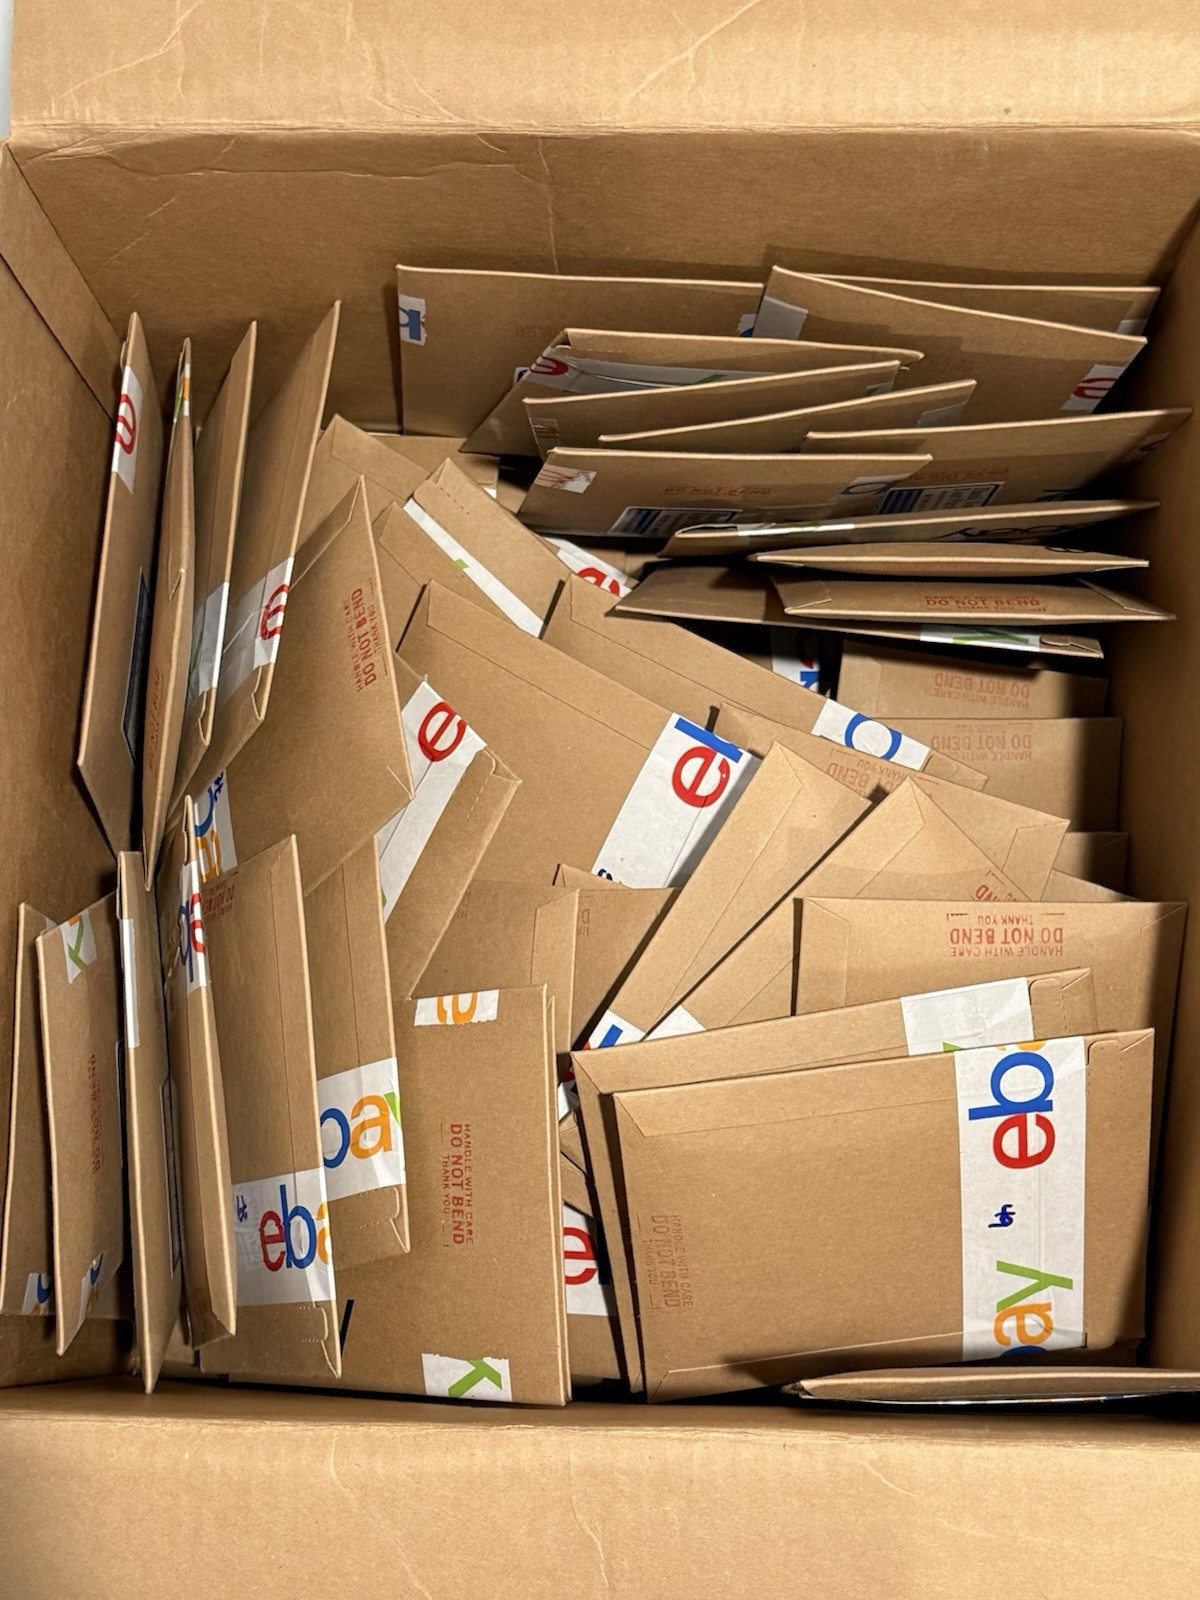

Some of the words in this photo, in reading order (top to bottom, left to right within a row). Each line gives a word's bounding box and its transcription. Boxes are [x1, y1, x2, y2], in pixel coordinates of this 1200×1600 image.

[351, 588, 367, 629] BEND
[926, 598, 949, 606] DO
[955, 598, 988, 606] NOT
[357, 631, 372, 661] NOT
[363, 662, 377, 686] DO
[934, 672, 973, 691] BEND
[976, 679, 1006, 696] NOT
[1010, 682, 1031, 699] DO
[931, 735, 972, 751] BEND
[976, 734, 1006, 751] NOT
[1011, 733, 1032, 750] DO
[977, 915, 998, 926] YOU
[1001, 914, 1034, 926] THANK
[950, 928, 995, 945] BEND
[1001, 927, 1034, 945] NOT
[1041, 927, 1064, 944] DO
[950, 946, 980, 957] CARE
[985, 946, 1014, 957] WITH
[1017, 946, 1063, 957] HANDLE
[968, 1041, 1056, 1169] eb
[450, 1123, 463, 1148] DO
[464, 1124, 472, 1172] HANDLE
[442, 1154, 450, 1189] THANK
[451, 1154, 464, 1190] NOT
[464, 1177, 473, 1207] WITH
[442, 1193, 451, 1215] YOU
[451, 1196, 464, 1245] BEND
[465, 1211, 474, 1245] CARE
[651, 1215, 670, 1234] DO
[654, 1239, 676, 1267] NOT
[670, 1215, 686, 1253] HANDLE
[680, 1281, 693, 1307] CARE
[660, 1270, 681, 1307] BEND
